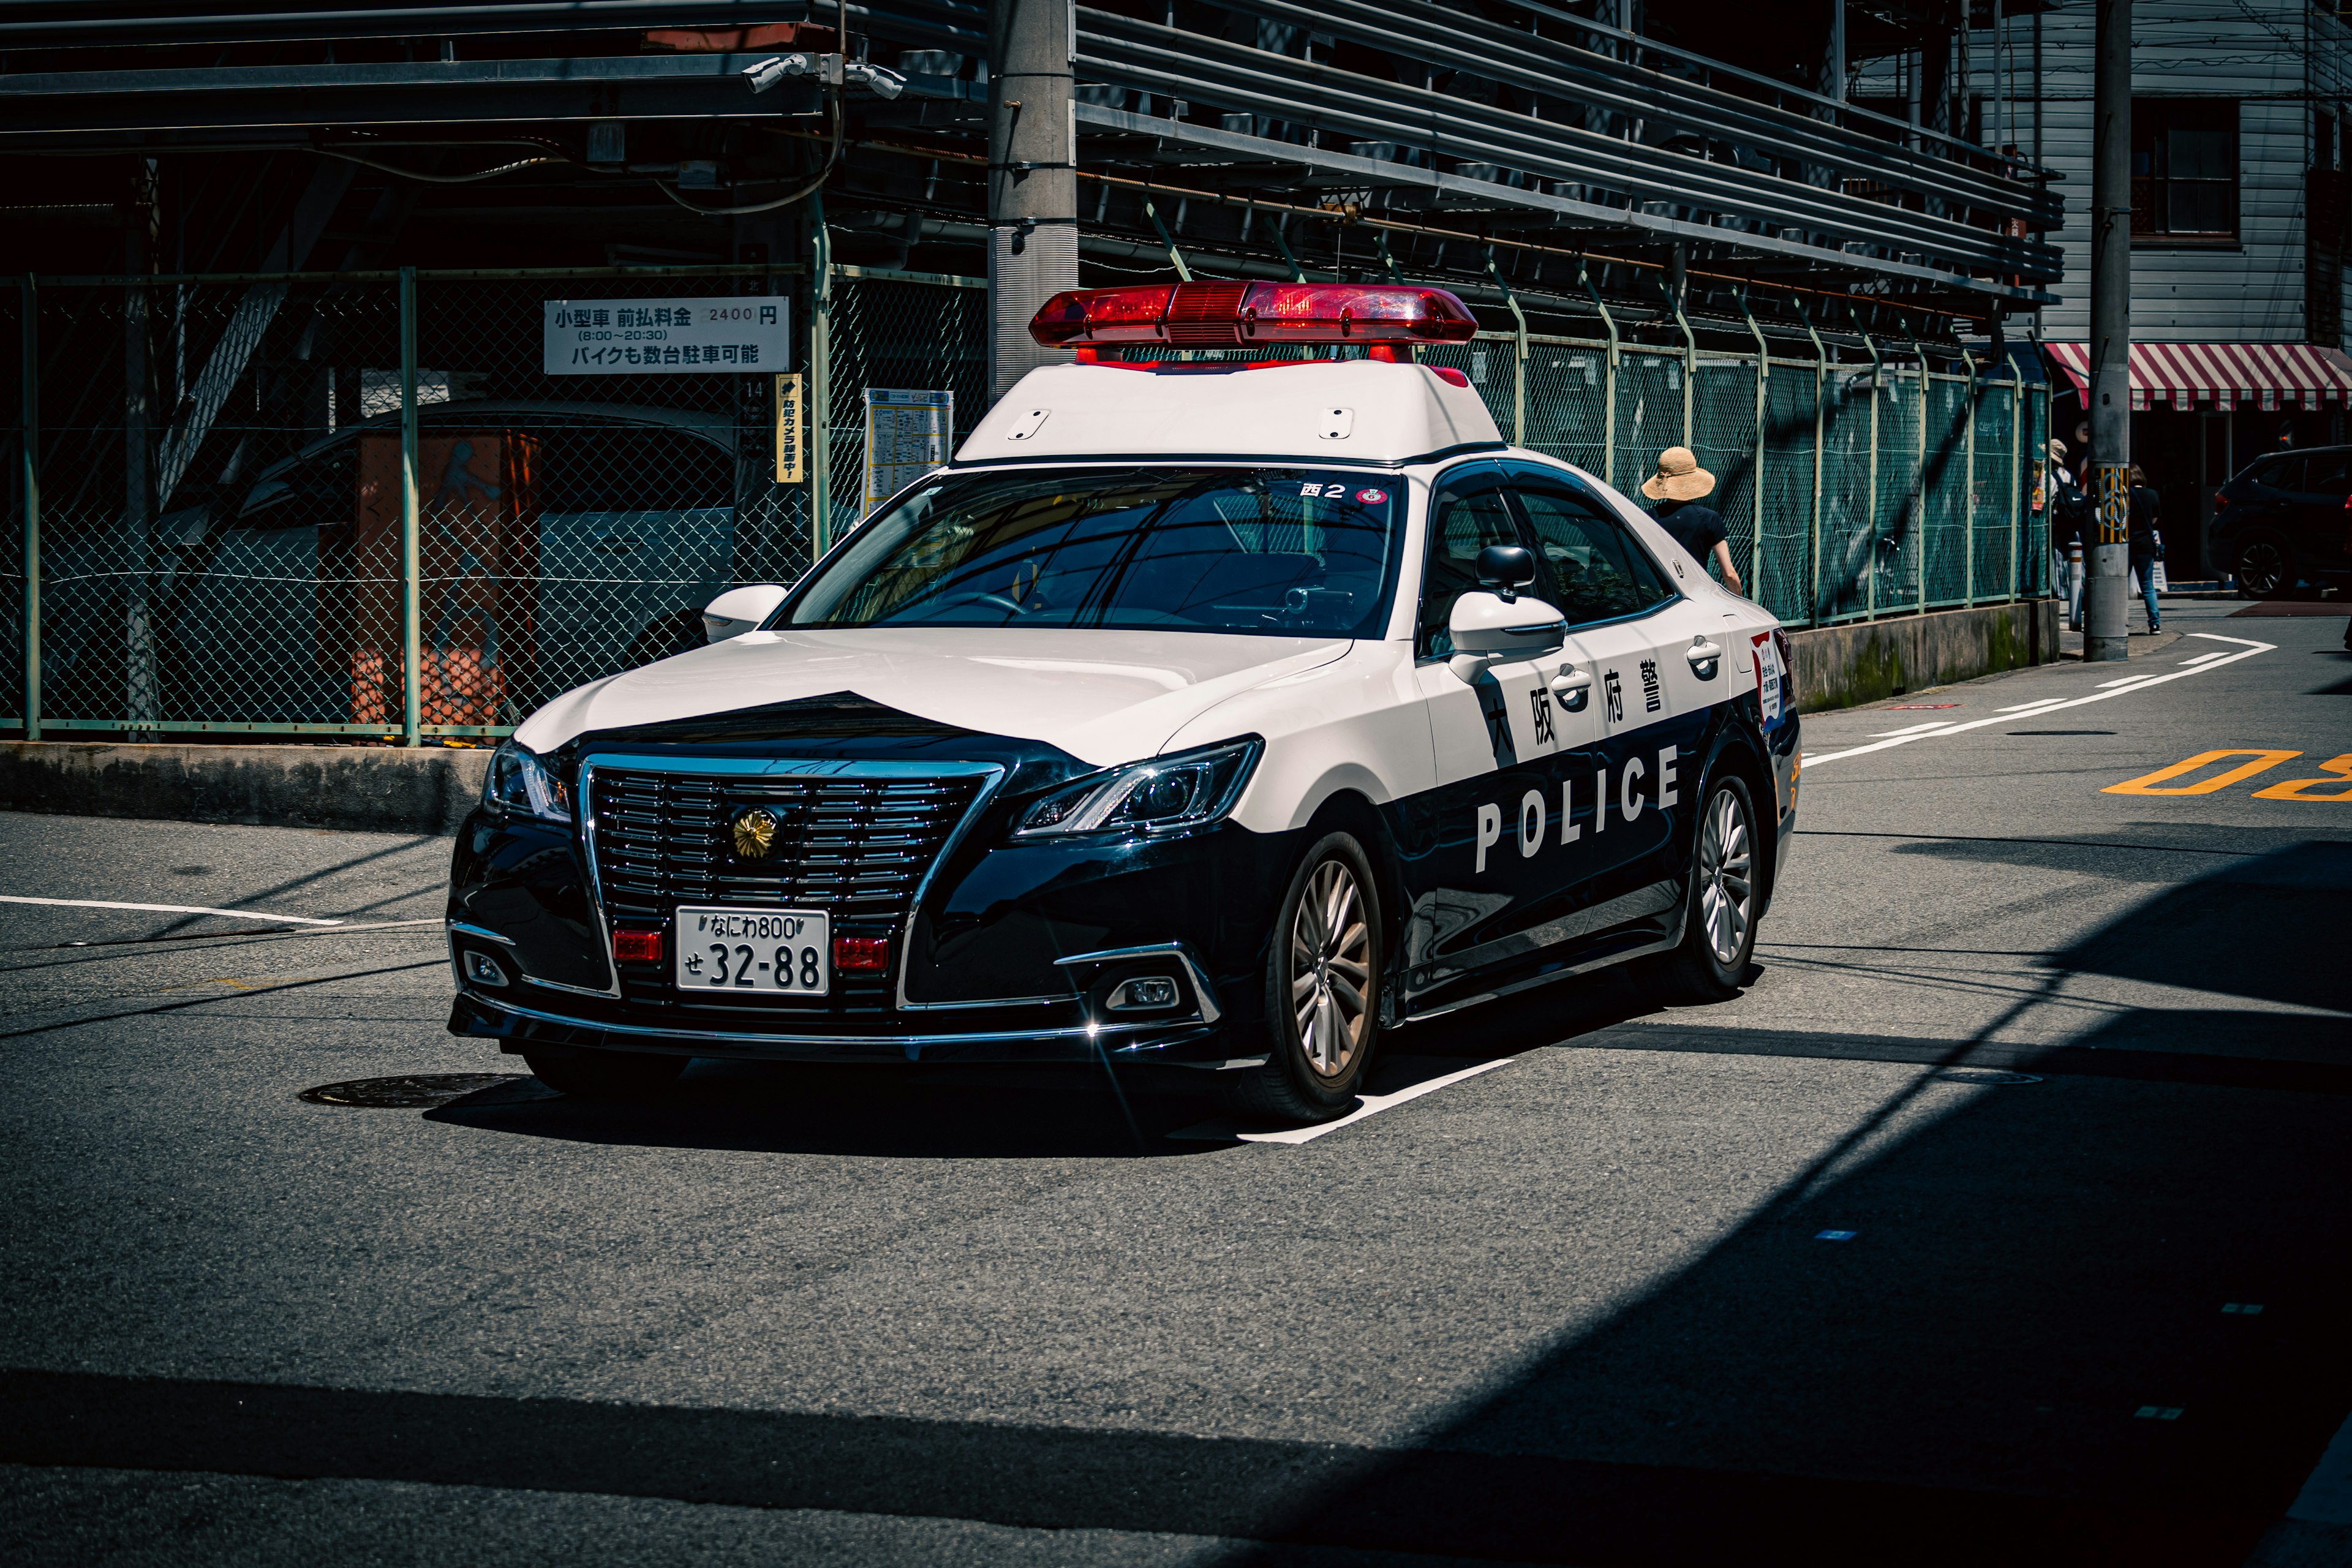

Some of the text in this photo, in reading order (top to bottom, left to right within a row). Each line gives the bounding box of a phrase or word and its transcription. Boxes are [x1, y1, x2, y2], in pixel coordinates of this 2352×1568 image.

[555, 306, 777, 328] 小型車 前払料金 2400 円
[571, 344, 759, 365] バイクも数台駐車可能
[747, 382, 763, 397] 14
[1476, 745, 1678, 873] POLICE
[685, 942, 820, 989] せ 32-88
